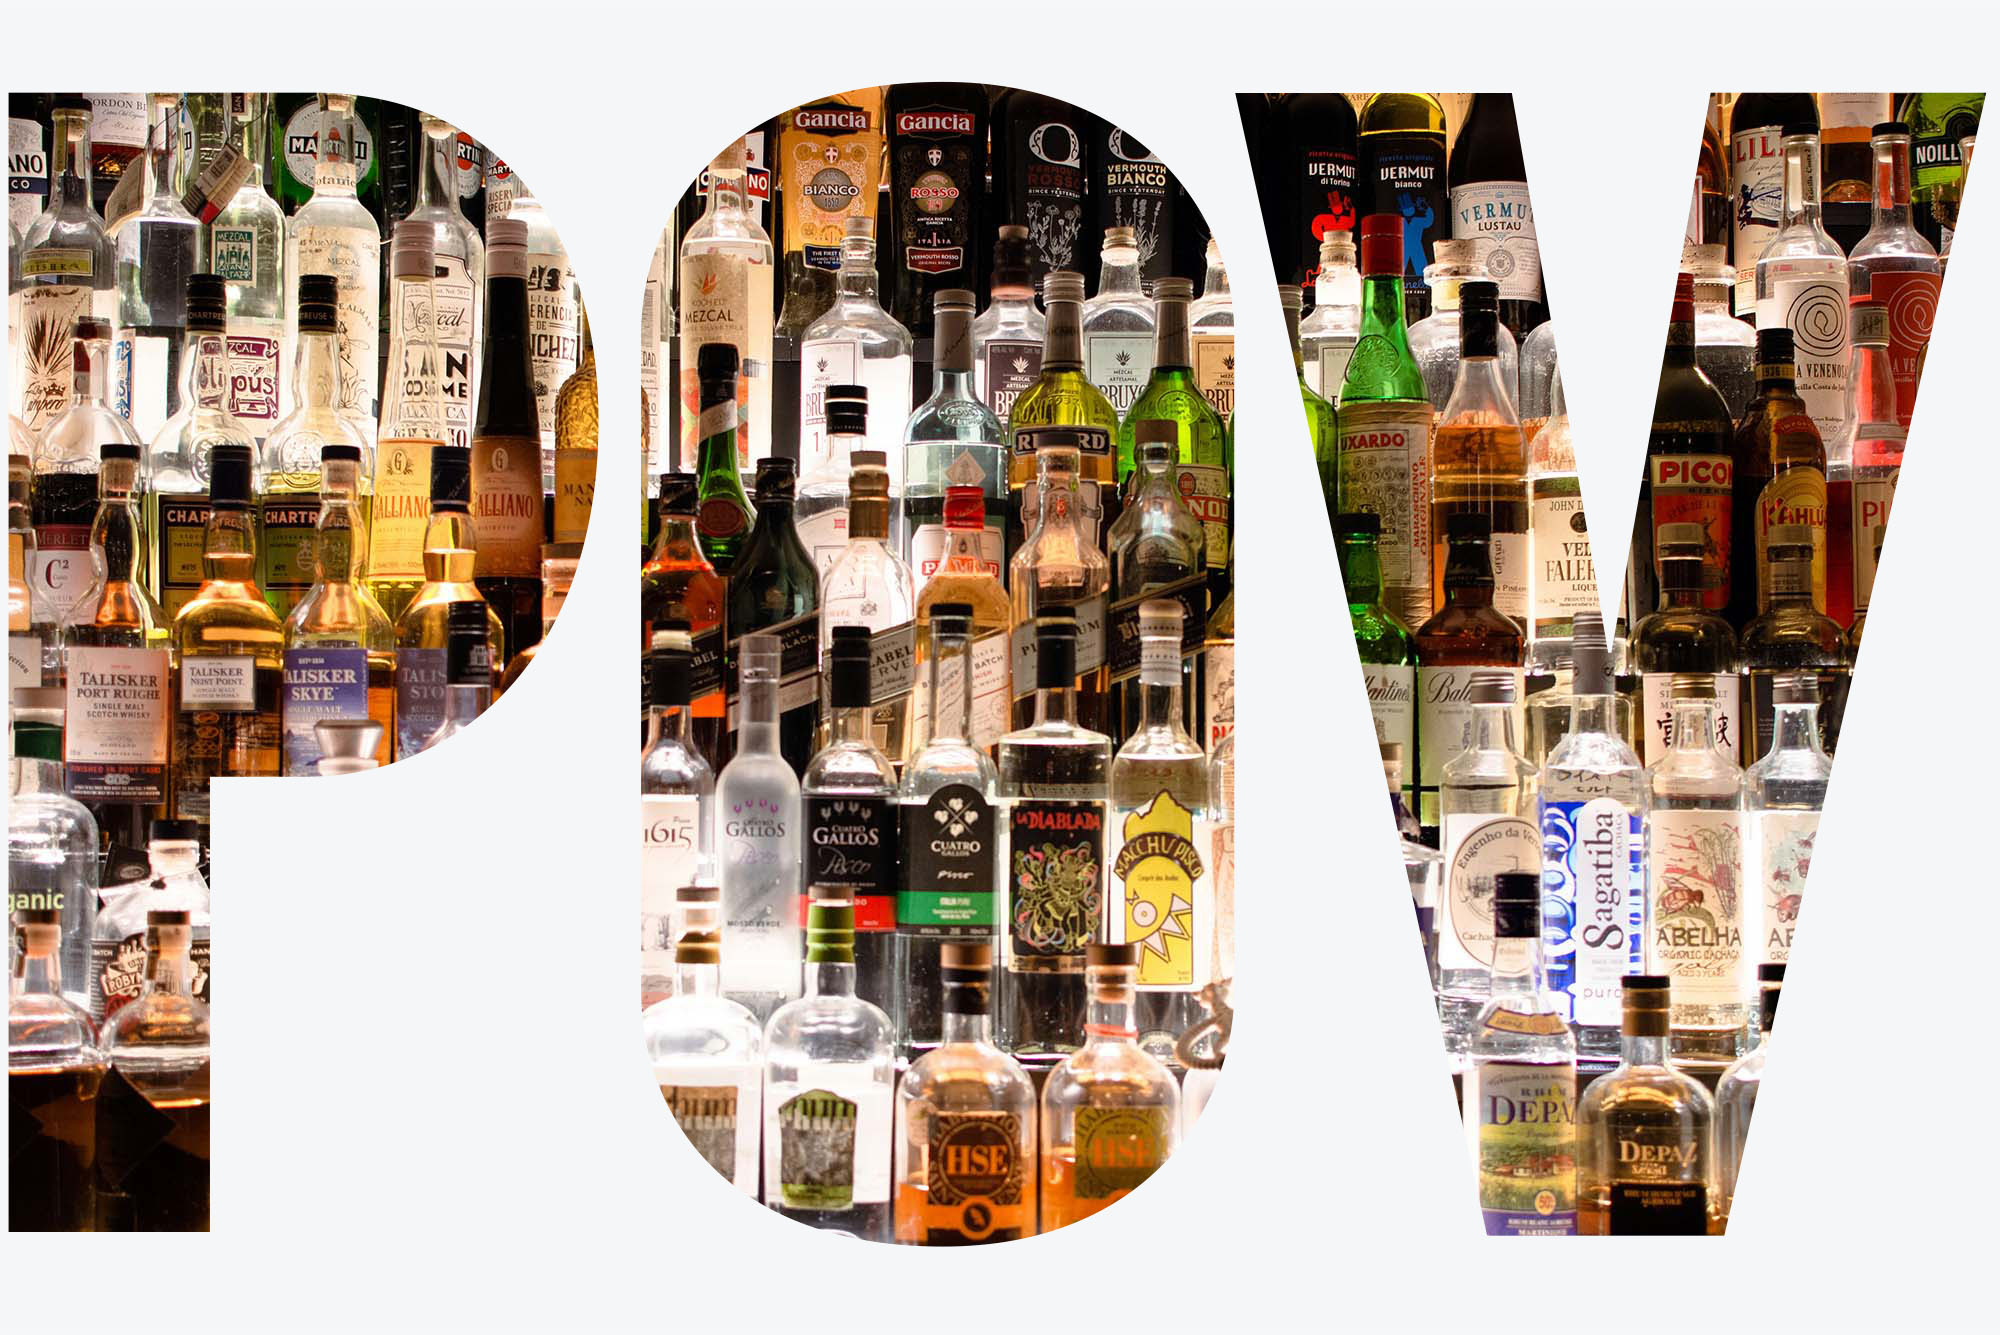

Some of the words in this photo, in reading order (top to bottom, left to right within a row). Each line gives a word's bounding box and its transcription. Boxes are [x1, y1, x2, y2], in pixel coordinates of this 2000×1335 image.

[92, 99, 133, 109] ORDON
[795, 111, 867, 129] Gancia
[901, 114, 970, 131] Gancia
[1107, 164, 1167, 174] VERMOUTH
[1309, 163, 1355, 179] VERMUT
[1381, 166, 1434, 181] VERMUT
[1107, 173, 1166, 187] BIANCO
[1320, 177, 1328, 186] di
[1395, 180, 1422, 188] bianco
[804, 185, 859, 196] BIANCO
[911, 187, 959, 199] ROSSO
[1479, 221, 1521, 231] LUSTAU
[217, 230, 250, 241] MEZCAL
[685, 309, 734, 324] MEZCAL
[536, 320, 547, 330] DE
[1017, 432, 1105, 450] RIRD
[1550, 500, 1575, 512] JOHN
[974, 655, 1003, 670] BATCH
[188, 667, 243, 676] TALISKER
[80, 671, 158, 688] TALISKER
[77, 687, 110, 698] PORT
[113, 688, 161, 700] RUIGHE
[291, 687, 334, 701] SKYE
[93, 702, 122, 710] SINGLE
[1028, 811, 1100, 830] DIABLADA
[644, 819, 693, 849] 1615
[726, 821, 786, 838] GALLOS
[813, 827, 879, 846] GALLOS
[832, 825, 865, 833] CUATRO
[931, 841, 981, 853] CUATRO
[1457, 830, 1503, 870] Engenho
[1505, 827, 1520, 838] da
[1116, 834, 1175, 877] MACCHU
[1176, 843, 1203, 878] PISCO
[1582, 810, 1624, 950] Sagatiba
[1656, 926, 1742, 948] ABELHA
[1619, 1140, 1697, 1164] DEPAZ
[947, 1145, 1008, 1176] HSE
